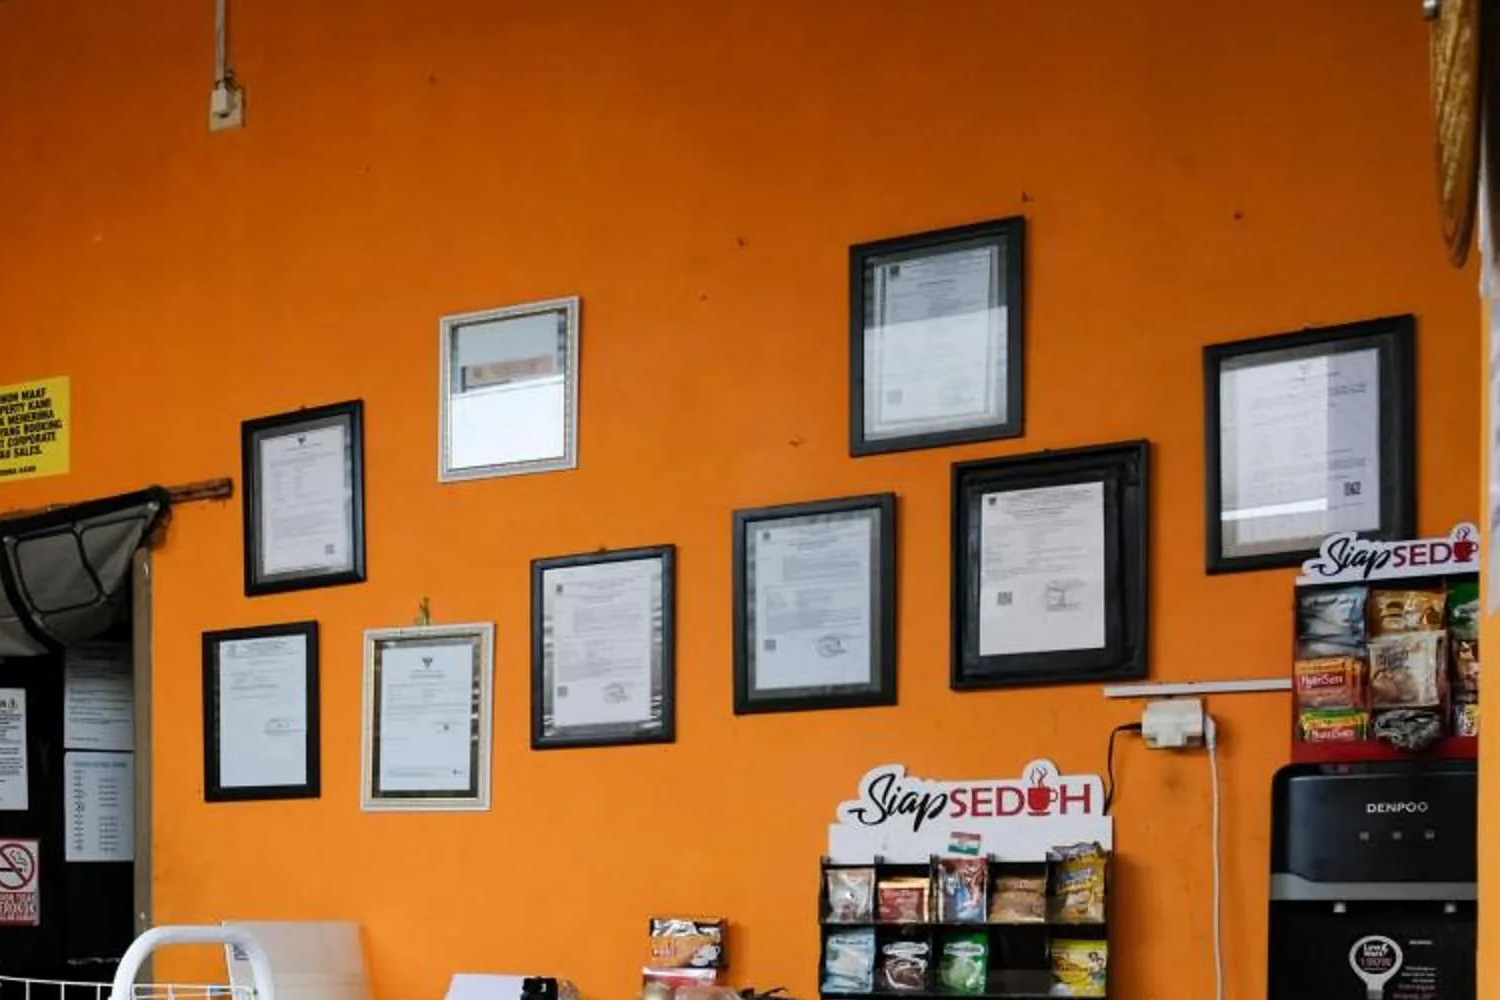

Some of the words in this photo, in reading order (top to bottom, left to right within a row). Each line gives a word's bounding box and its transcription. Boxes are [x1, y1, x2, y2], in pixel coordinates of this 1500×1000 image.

[1310, 537, 1391, 578] Siap
[848, 772, 948, 832] Siap
[1366, 801, 1429, 813] DENPOO
